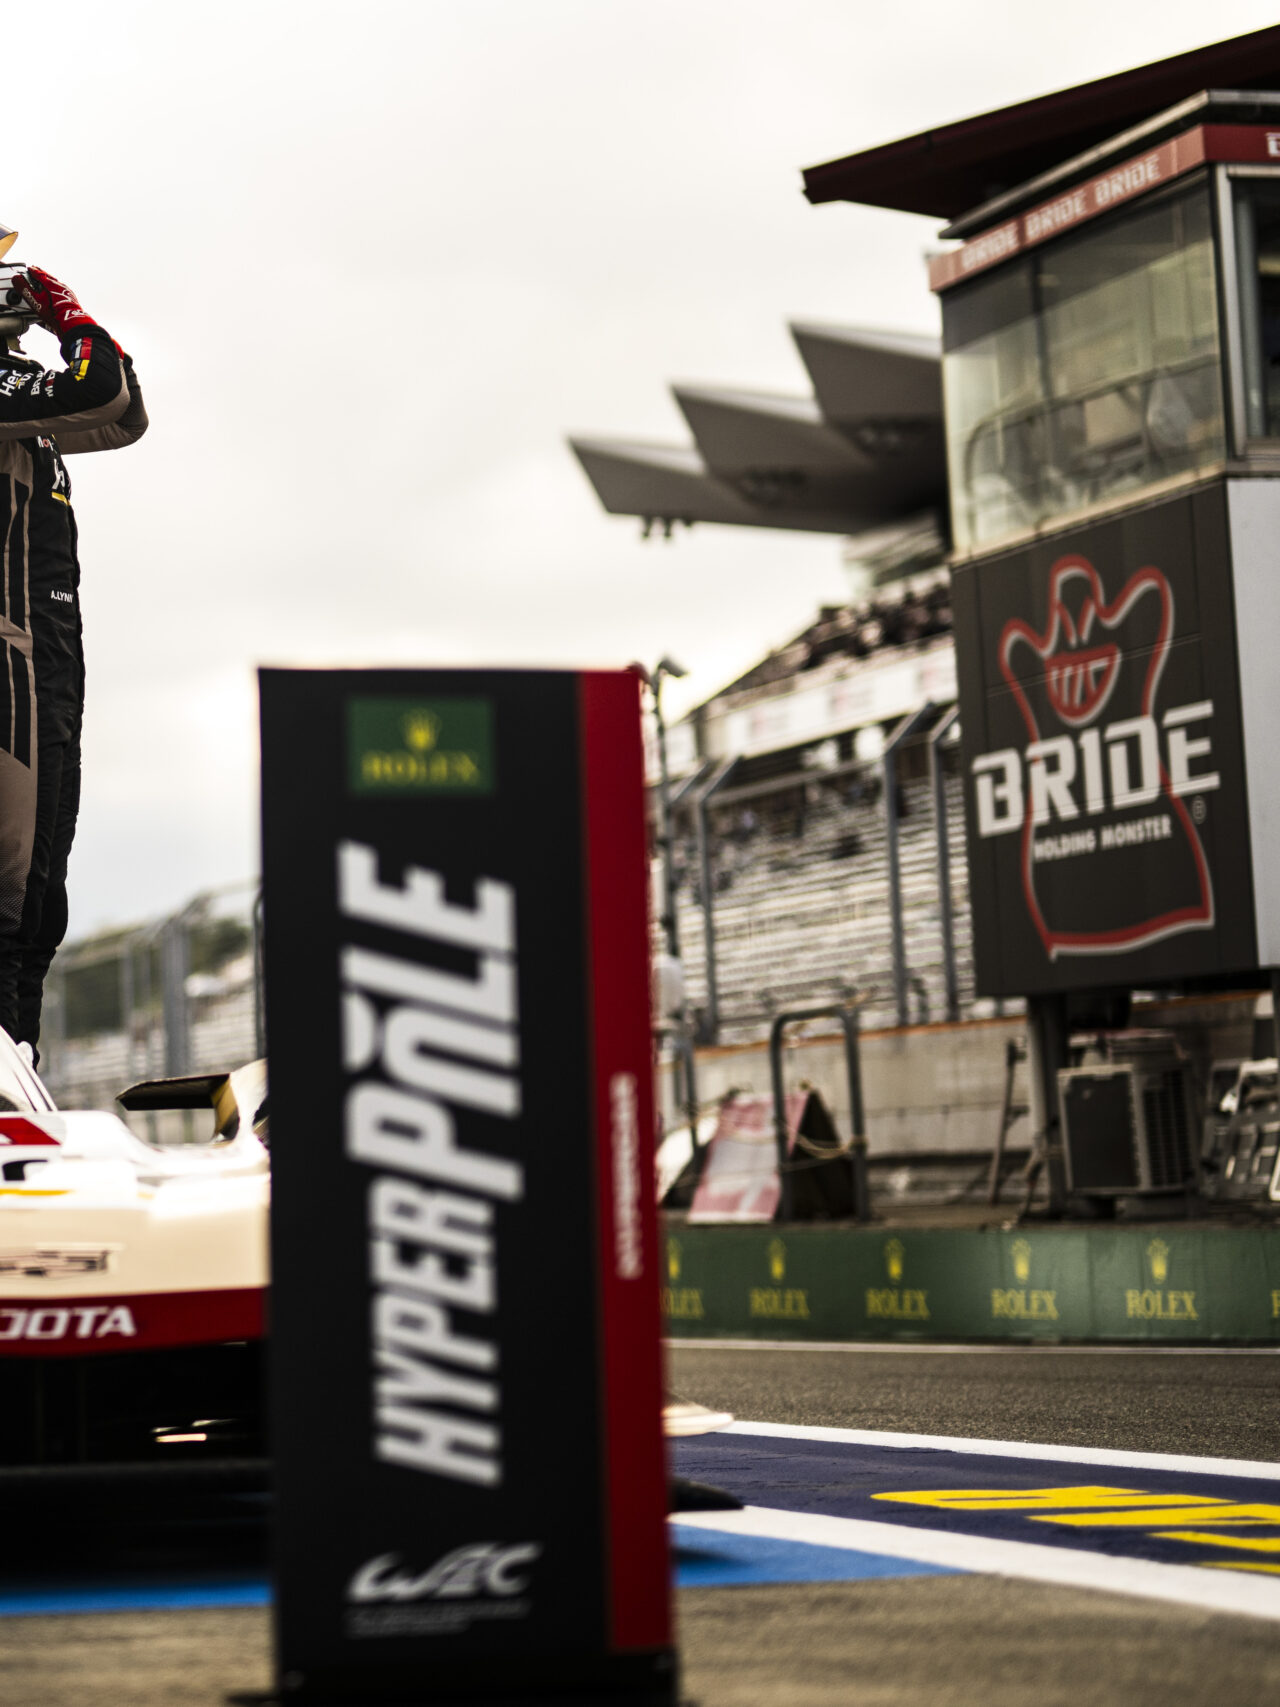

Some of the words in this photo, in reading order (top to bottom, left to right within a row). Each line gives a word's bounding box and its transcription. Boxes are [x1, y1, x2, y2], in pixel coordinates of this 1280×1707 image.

[961, 220, 1019, 271] BRIDE
[1025, 190, 1088, 240] BRIDE
[1095, 154, 1162, 206] BRIDE
[971, 699, 1221, 838] BRIDE
[1033, 828, 1096, 863] HOLDING
[1101, 814, 1172, 851] MONSTER
[662, 1287, 704, 1320] OLEX
[750, 1287, 810, 1319] ROLEX
[865, 1287, 931, 1320] ROLEX
[991, 1288, 1059, 1320] ROLEX
[1125, 1288, 1199, 1320] ROLEX
